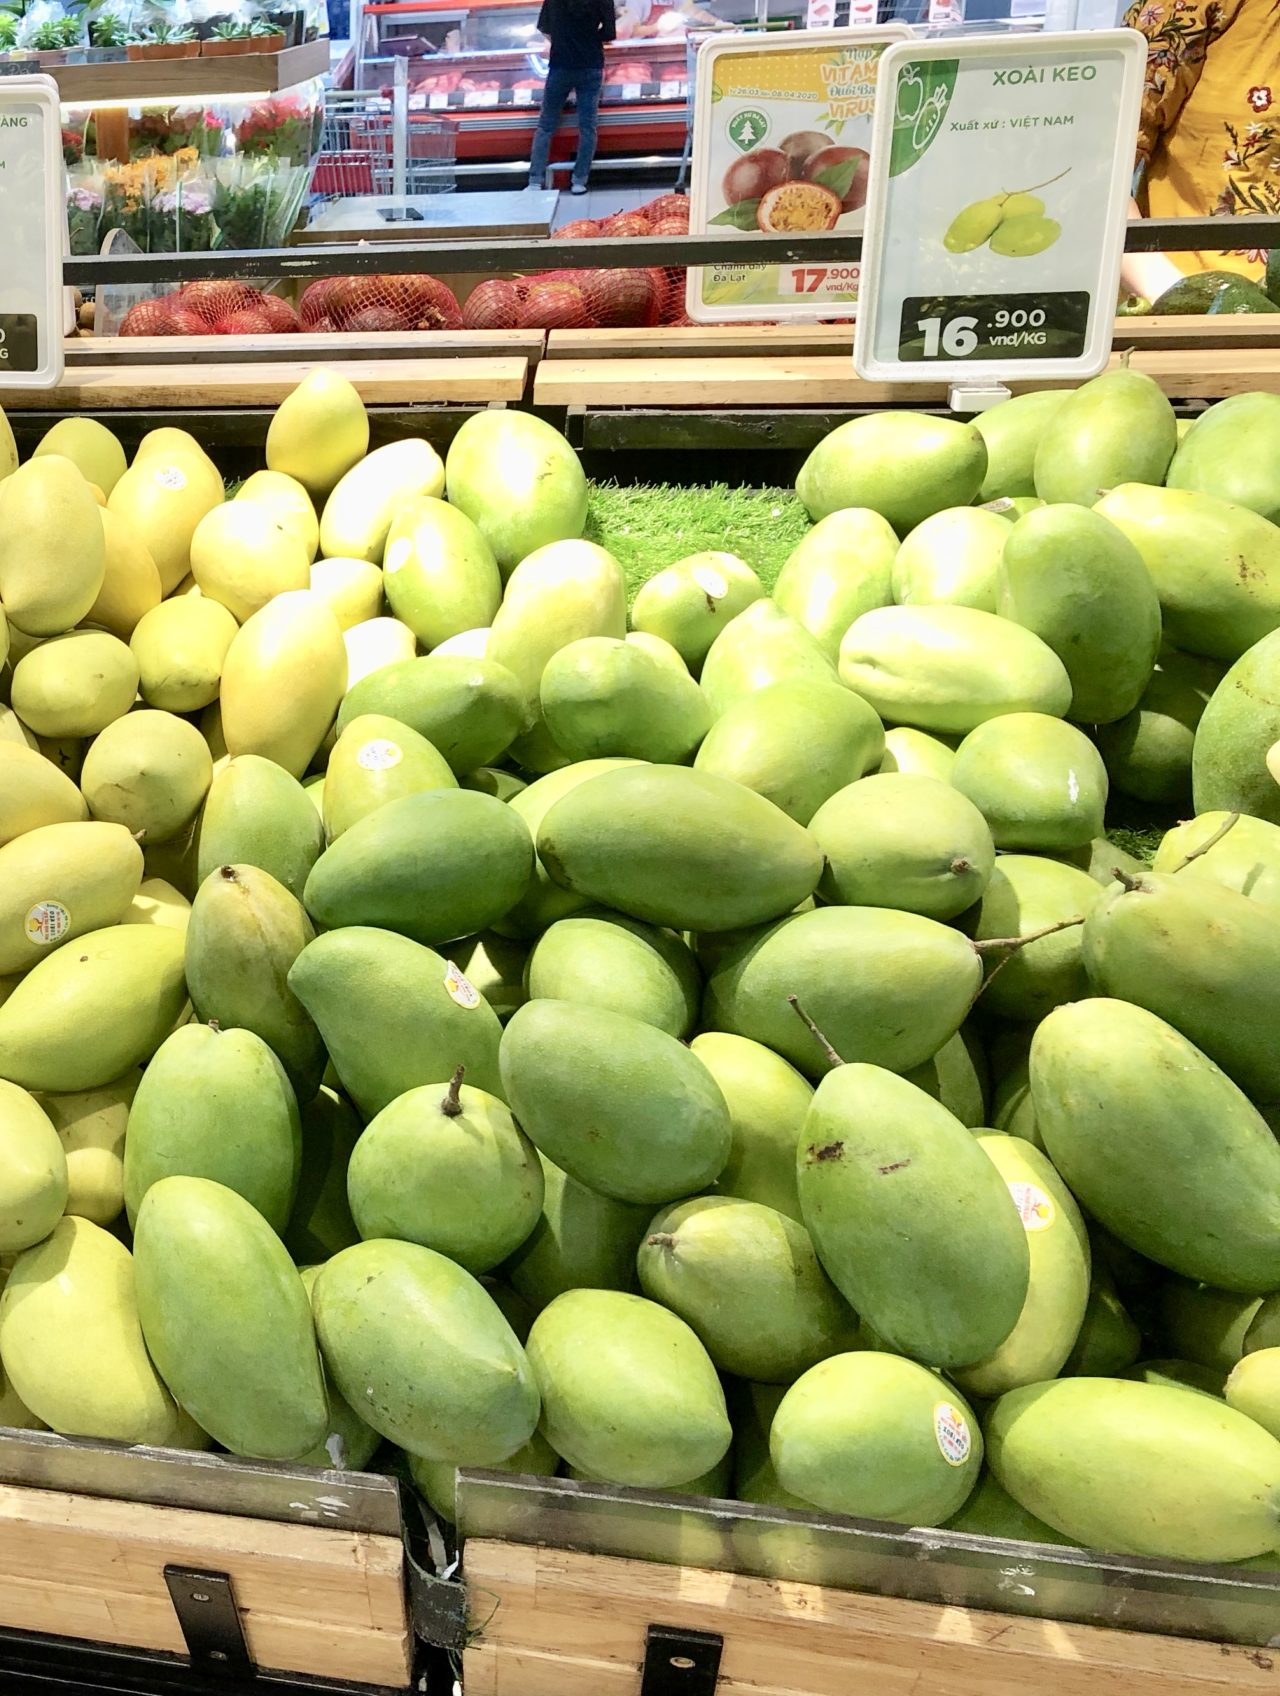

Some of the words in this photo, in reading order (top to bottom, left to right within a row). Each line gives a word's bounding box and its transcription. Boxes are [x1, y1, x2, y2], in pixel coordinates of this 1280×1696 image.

[992, 65, 1045, 86] XOÀI
[1052, 65, 1097, 82] KEO
[950, 119, 980, 132] Xuất
[982, 118, 1000, 130] xứ
[1010, 115, 1040, 130] VIỆT
[1043, 115, 1074, 127] NAM
[792, 268, 828, 293] 17
[827, 268, 860, 280] .900
[917, 316, 979, 357] 16
[987, 309, 1046, 329] .900
[989, 331, 1047, 347] vnd/KG
